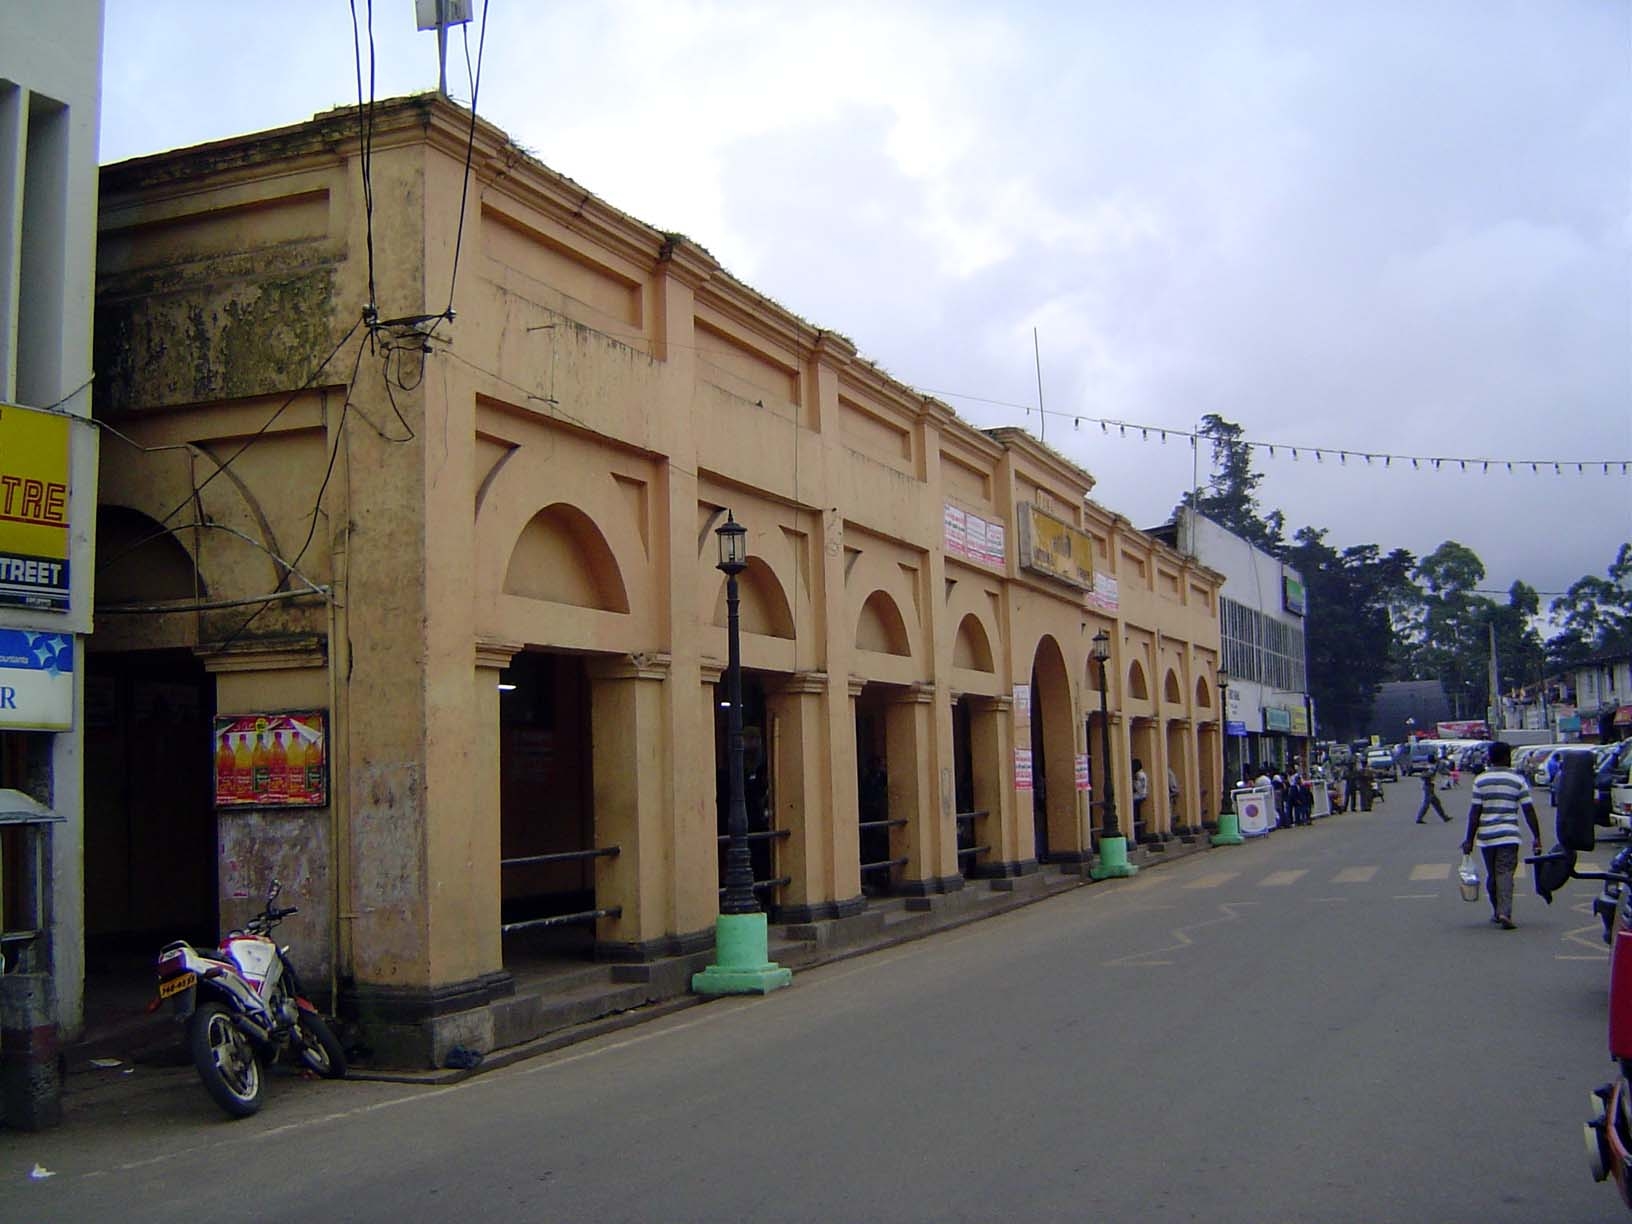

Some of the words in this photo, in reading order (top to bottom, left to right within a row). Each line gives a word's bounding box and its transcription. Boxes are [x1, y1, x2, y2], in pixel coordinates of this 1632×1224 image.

[1, 475, 66, 519] TRE
[0, 558, 62, 585] TREET
[0, 686, 17, 709] R
